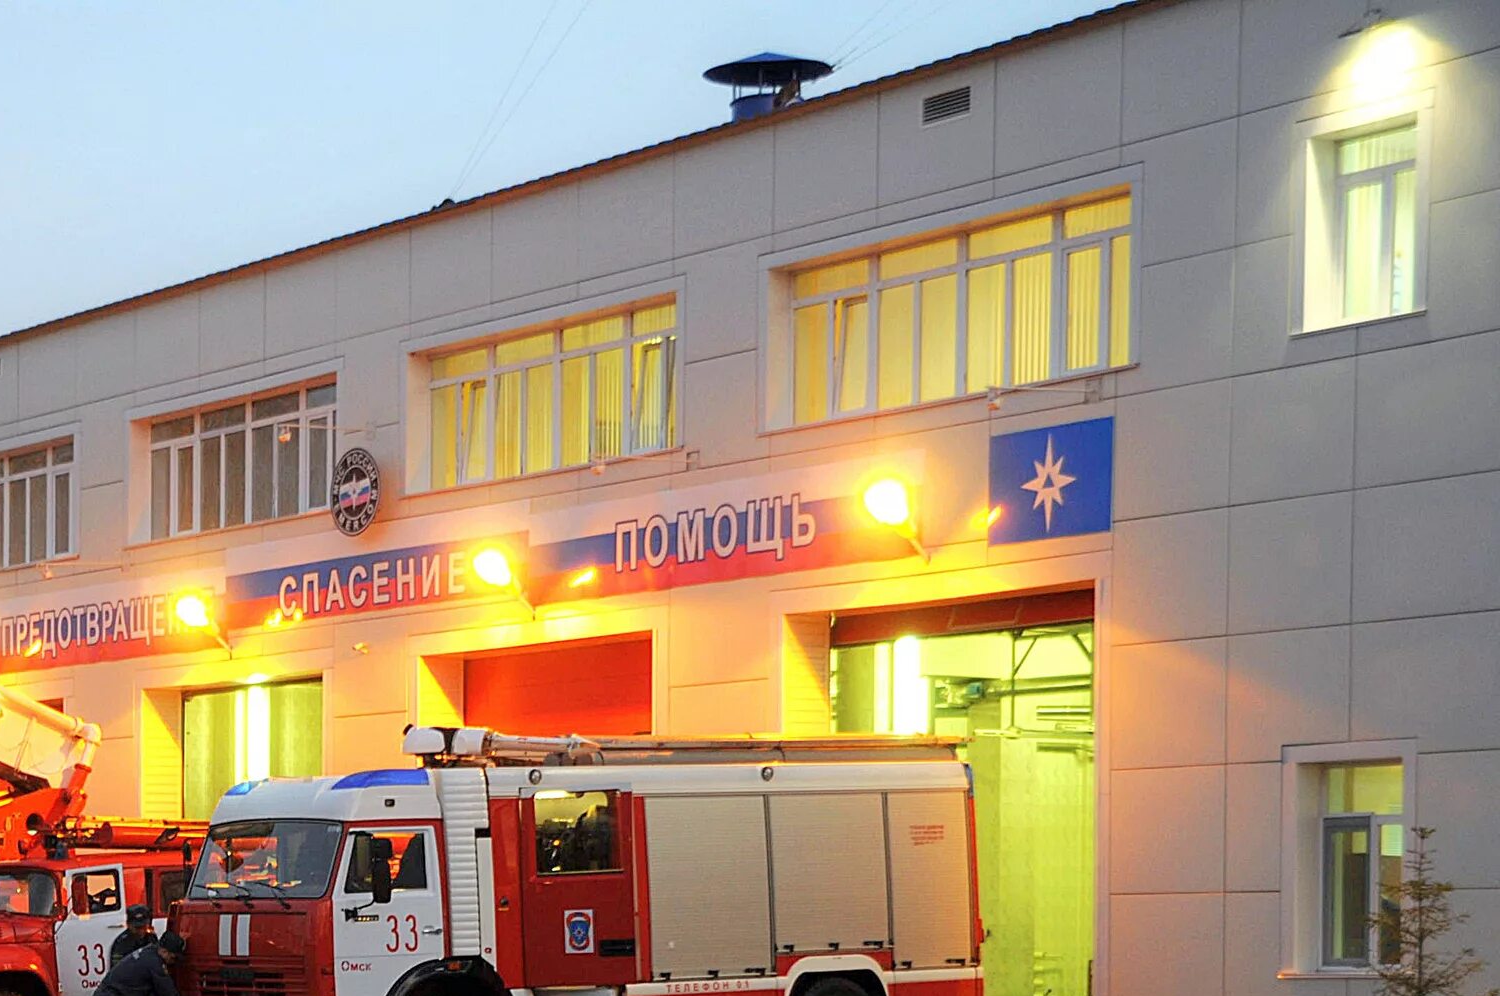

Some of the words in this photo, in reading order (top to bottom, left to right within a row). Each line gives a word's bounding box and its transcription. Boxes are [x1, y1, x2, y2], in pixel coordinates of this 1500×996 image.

[615, 493, 817, 573] ПОМОЩЬ
[279, 551, 466, 617] СПАСЕНИЕ
[1, 587, 213, 659] ПРЕДОТВРАЩЕ
[386, 914, 418, 952] 33
[78, 943, 105, 976] 33
[666, 982, 729, 993] ТЕЛЕФОН
